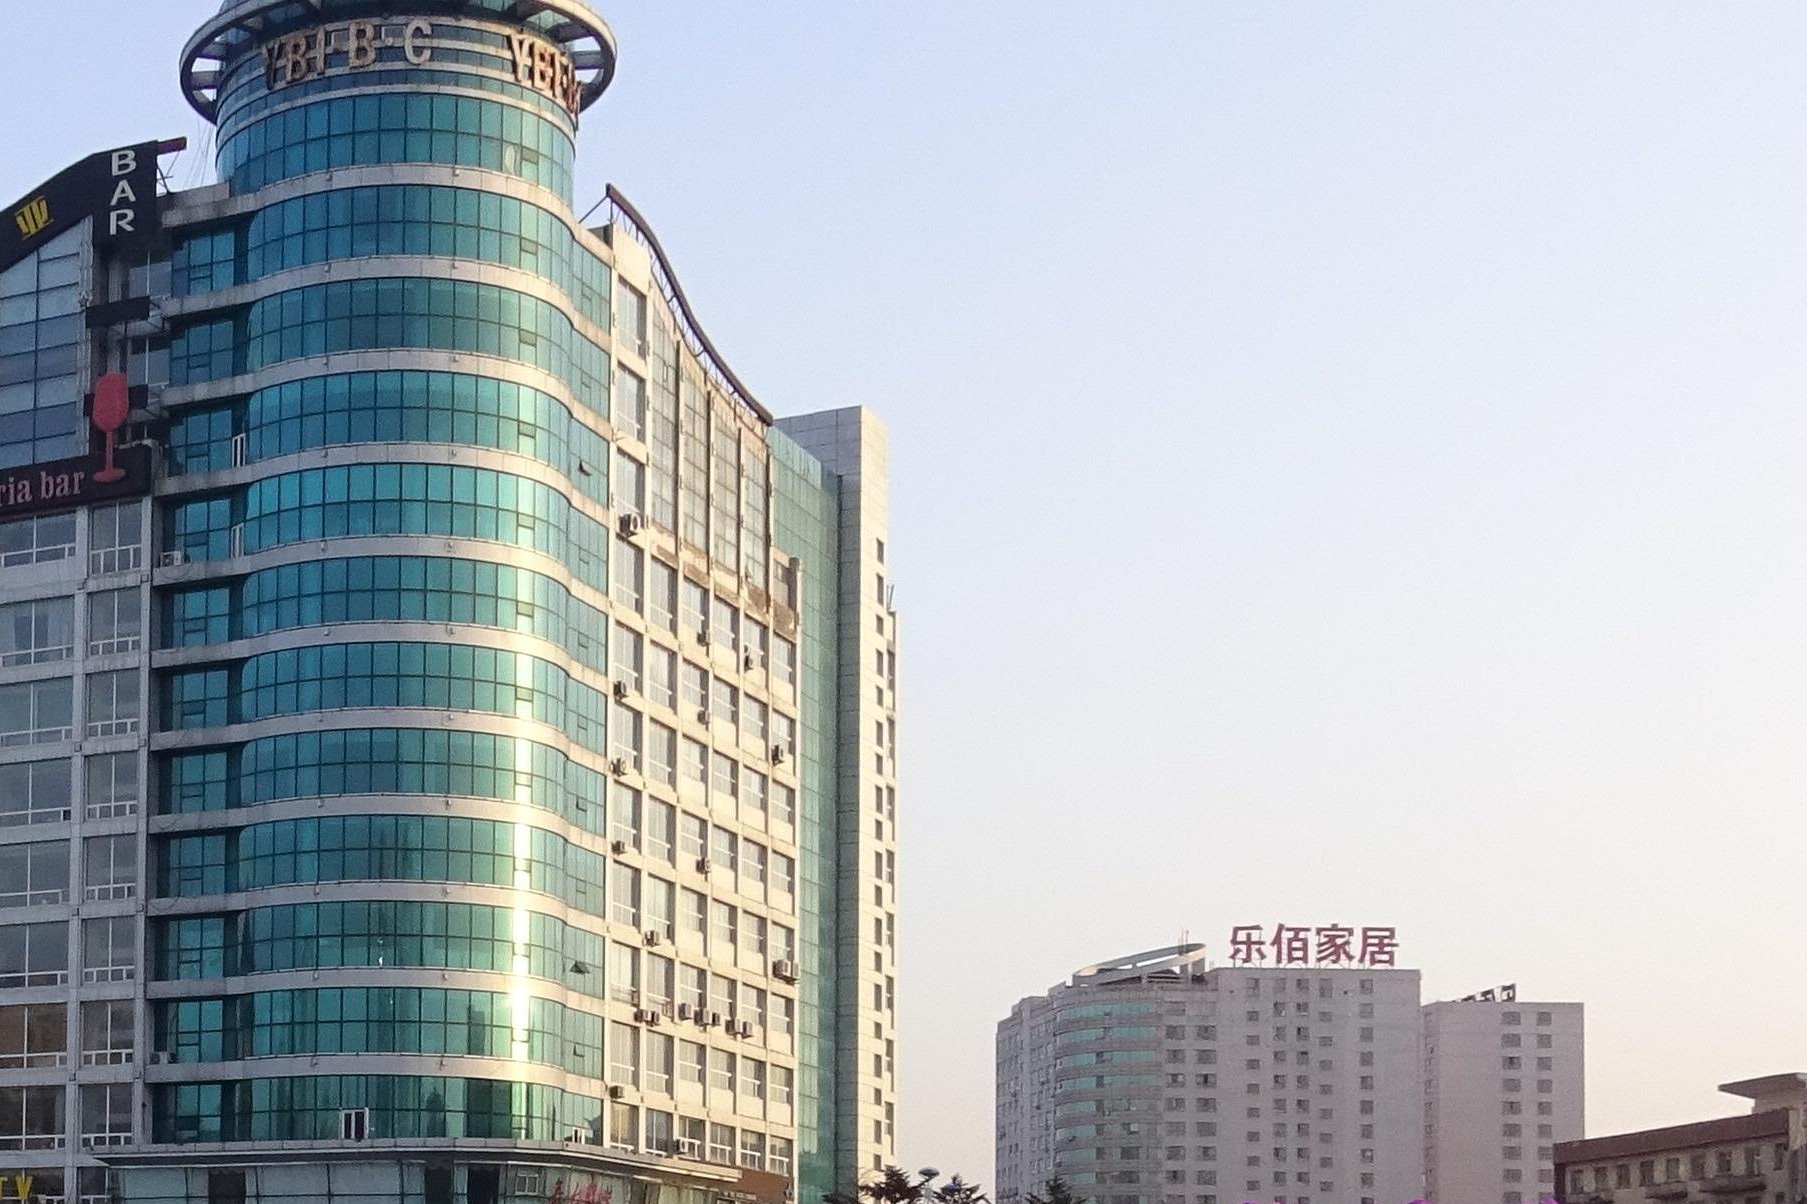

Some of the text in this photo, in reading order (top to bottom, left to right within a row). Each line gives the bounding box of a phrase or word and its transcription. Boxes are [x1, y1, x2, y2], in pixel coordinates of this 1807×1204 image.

[108, 149, 137, 236] BAR
[39, 466, 86, 497] bar
[1228, 922, 1399, 967] 乐佰家居
